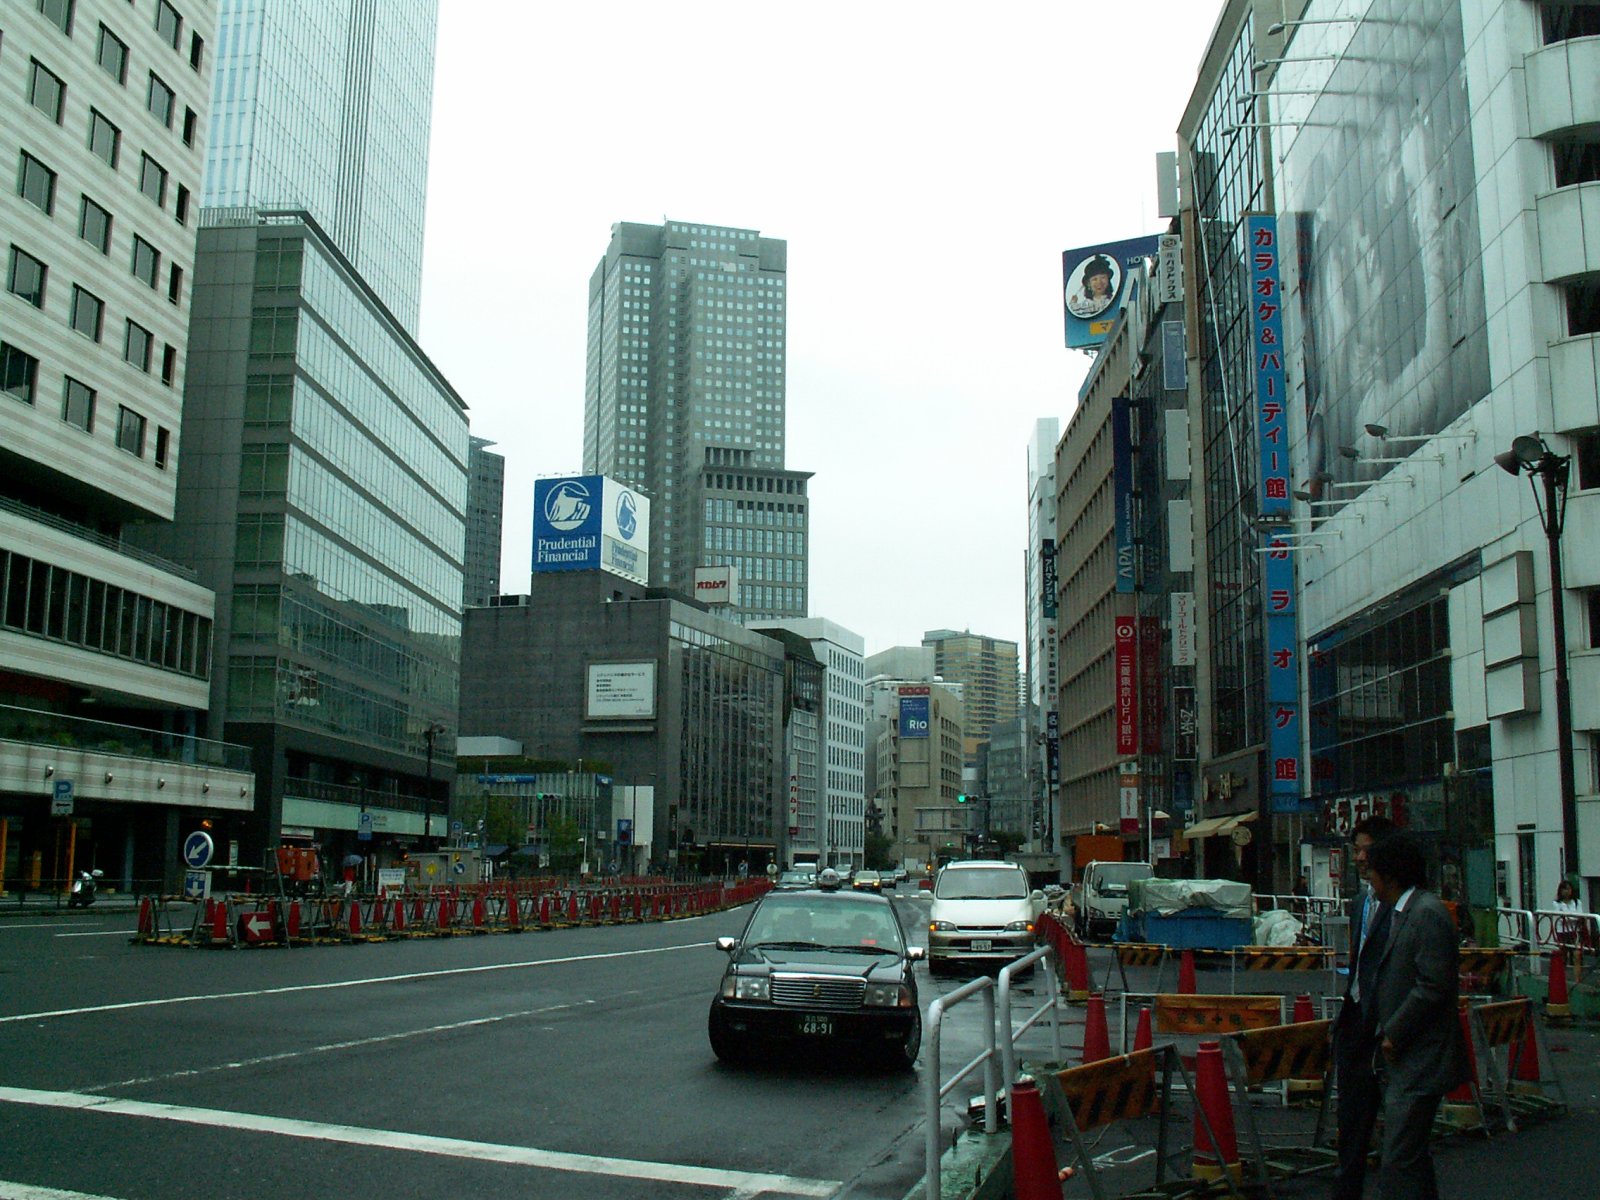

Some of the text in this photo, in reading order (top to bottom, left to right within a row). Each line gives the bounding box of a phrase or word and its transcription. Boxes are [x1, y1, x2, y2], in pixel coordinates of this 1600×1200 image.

[1254, 228, 1287, 500] カラオケ&パーティー館
[538, 535, 596, 552] Prudential
[537, 549, 589, 564] Financial
[1118, 545, 1133, 579] APA
[697, 580, 727, 590] オカムラ
[1269, 539, 1298, 781] カラオケ館
[55, 781, 71, 799] P
[362, 814, 370, 825] P
